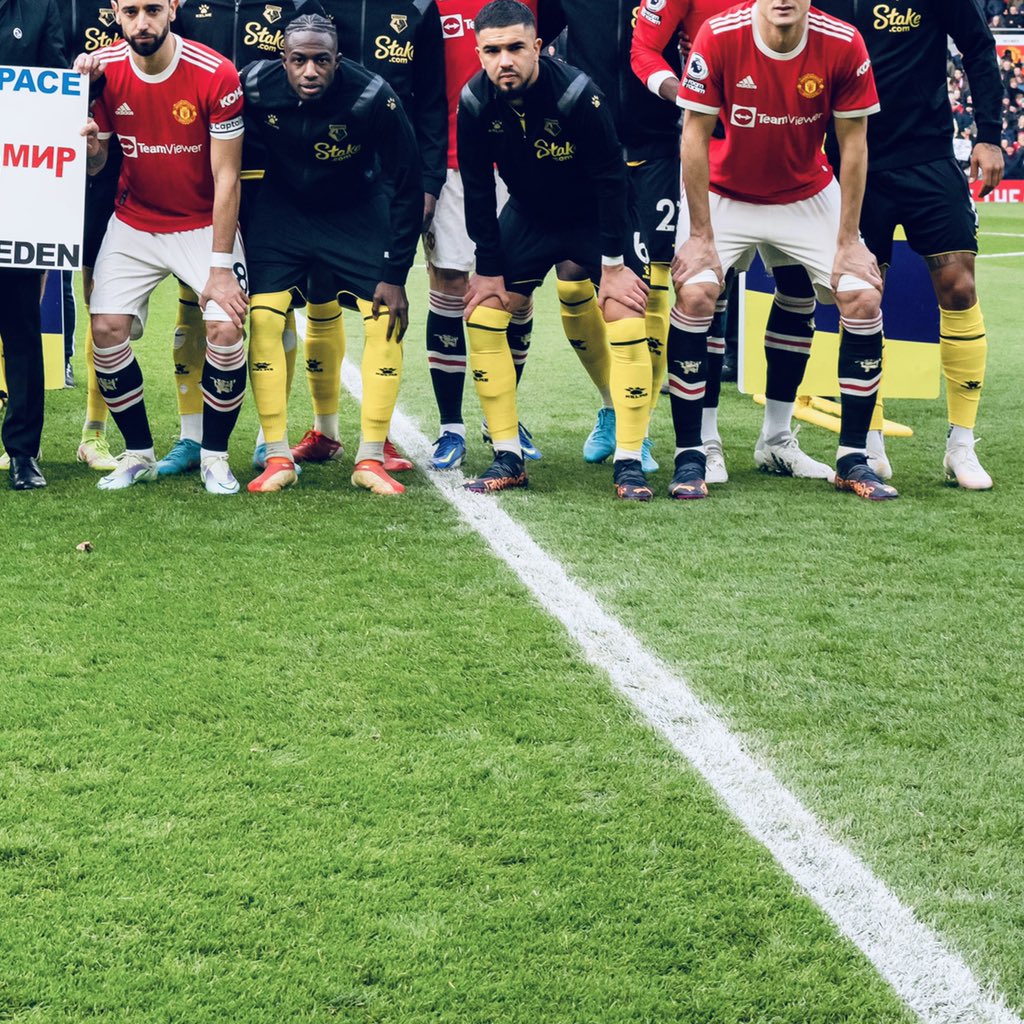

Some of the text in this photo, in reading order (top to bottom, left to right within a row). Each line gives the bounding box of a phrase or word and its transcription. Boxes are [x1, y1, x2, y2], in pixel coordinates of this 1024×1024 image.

[873, 4, 922, 30] Stake
[388, 56, 408, 64] .com
[137, 142, 203, 155] TeamViewer
